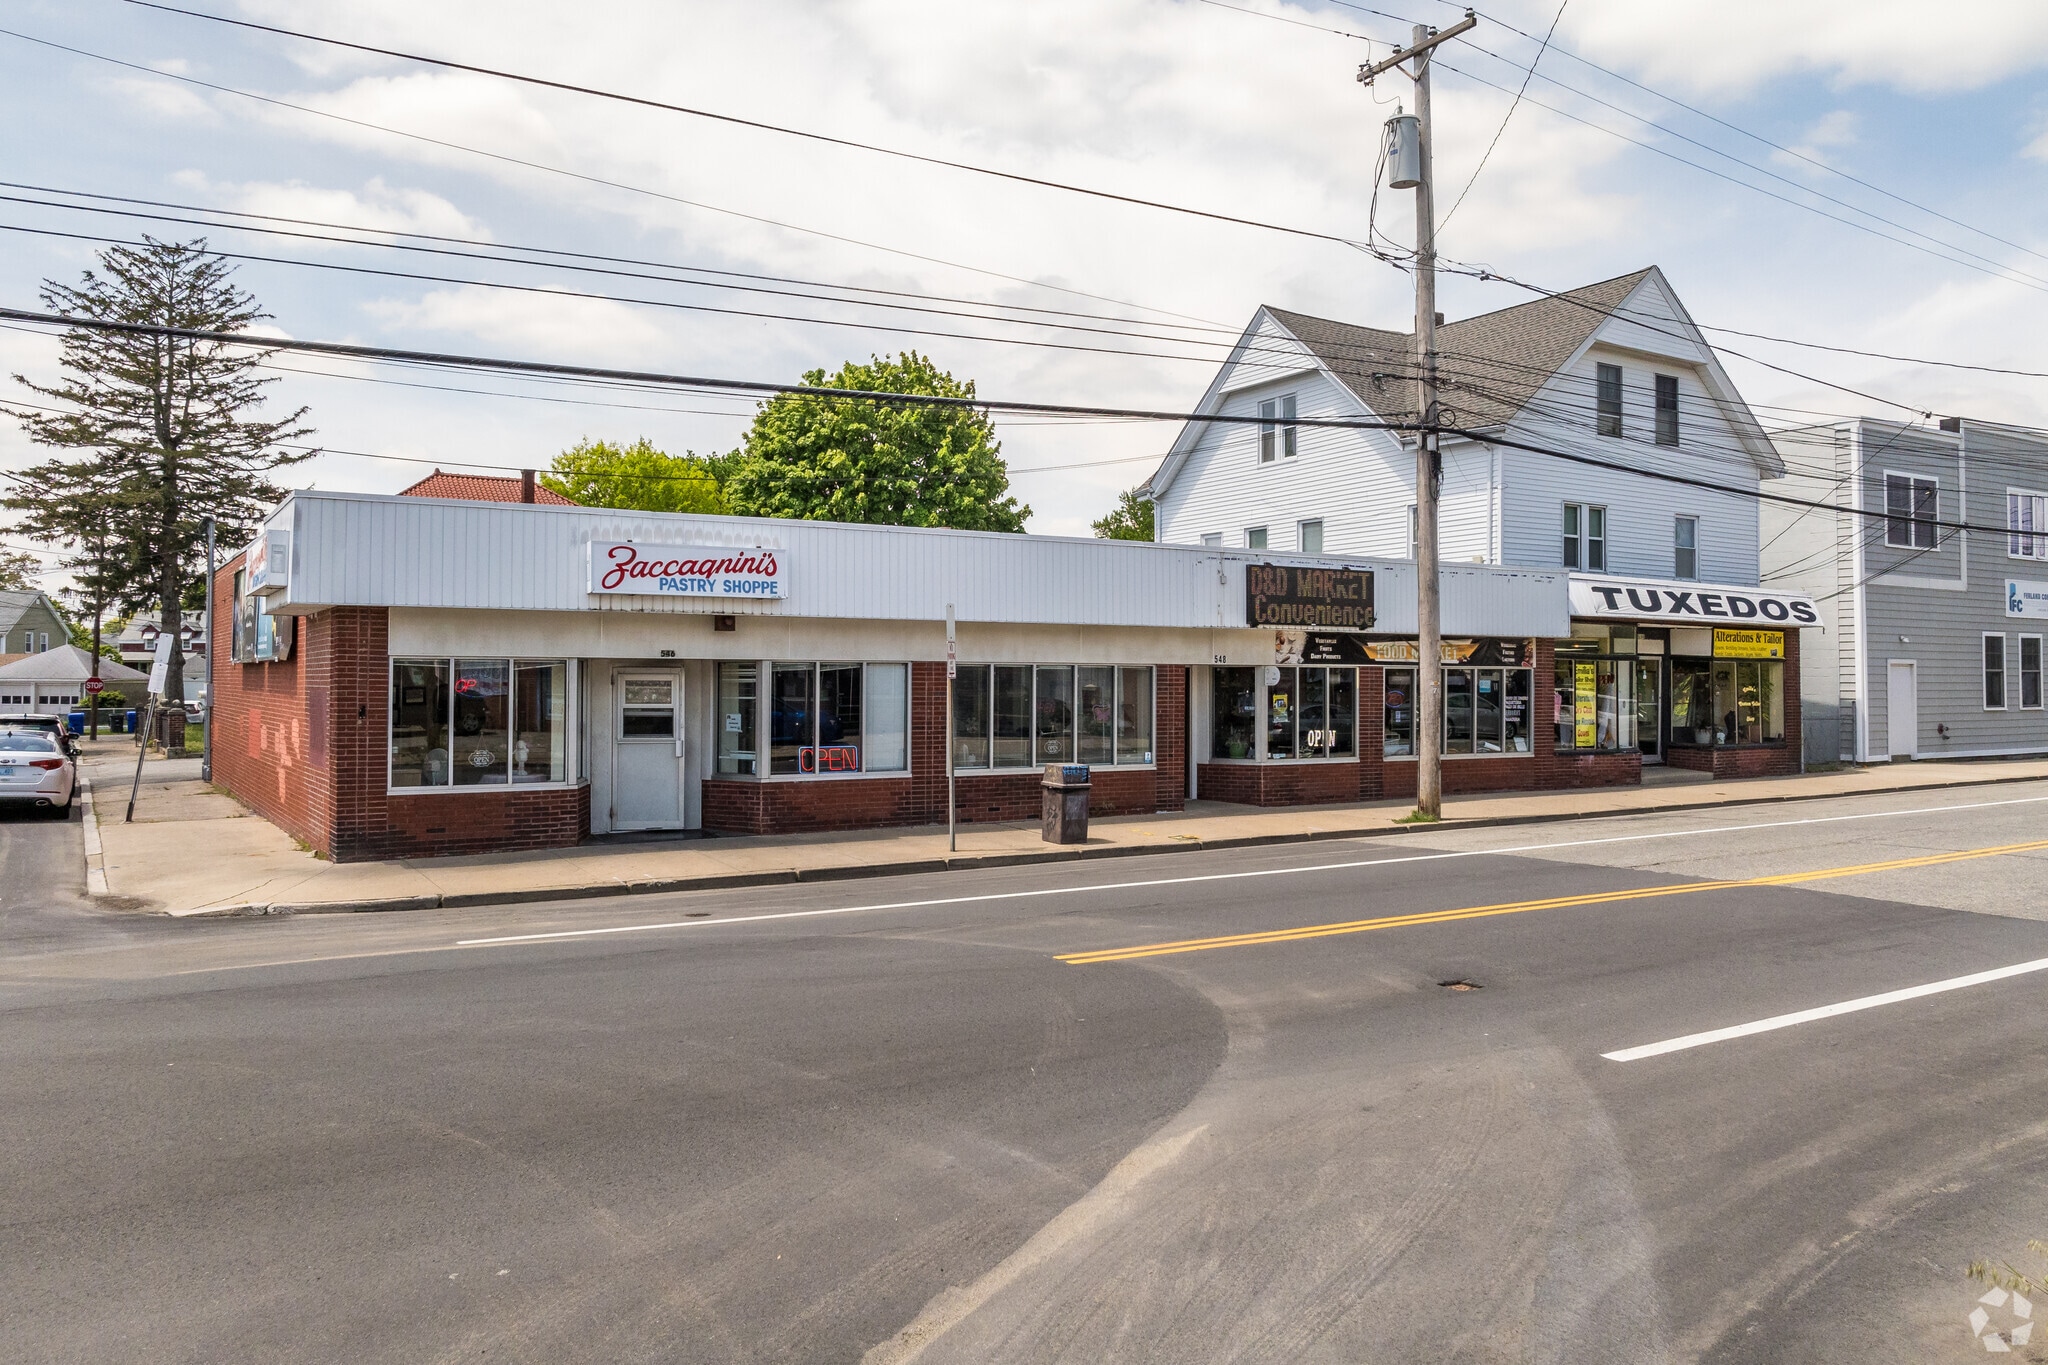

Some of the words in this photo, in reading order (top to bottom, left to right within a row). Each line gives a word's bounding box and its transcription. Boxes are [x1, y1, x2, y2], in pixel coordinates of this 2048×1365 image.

[601, 545, 778, 590] Zaccagnini's
[659, 577, 717, 593] PASTRY
[723, 579, 778, 595] SHOPPE
[1251, 566, 1288, 596] D&D
[1255, 594, 1373, 626] Convenience
[1591, 586, 1818, 623] TUXEDOS
[1715, 631, 1754, 643] Alterations
[1755, 633, 1762, 644] &
[1763, 633, 1783, 645] Tailor
[1214, 655, 1227, 664] 548
[1376, 645, 1407, 659] FOOD
[86, 681, 104, 690] STOP
[801, 748, 856, 771] OPEN
